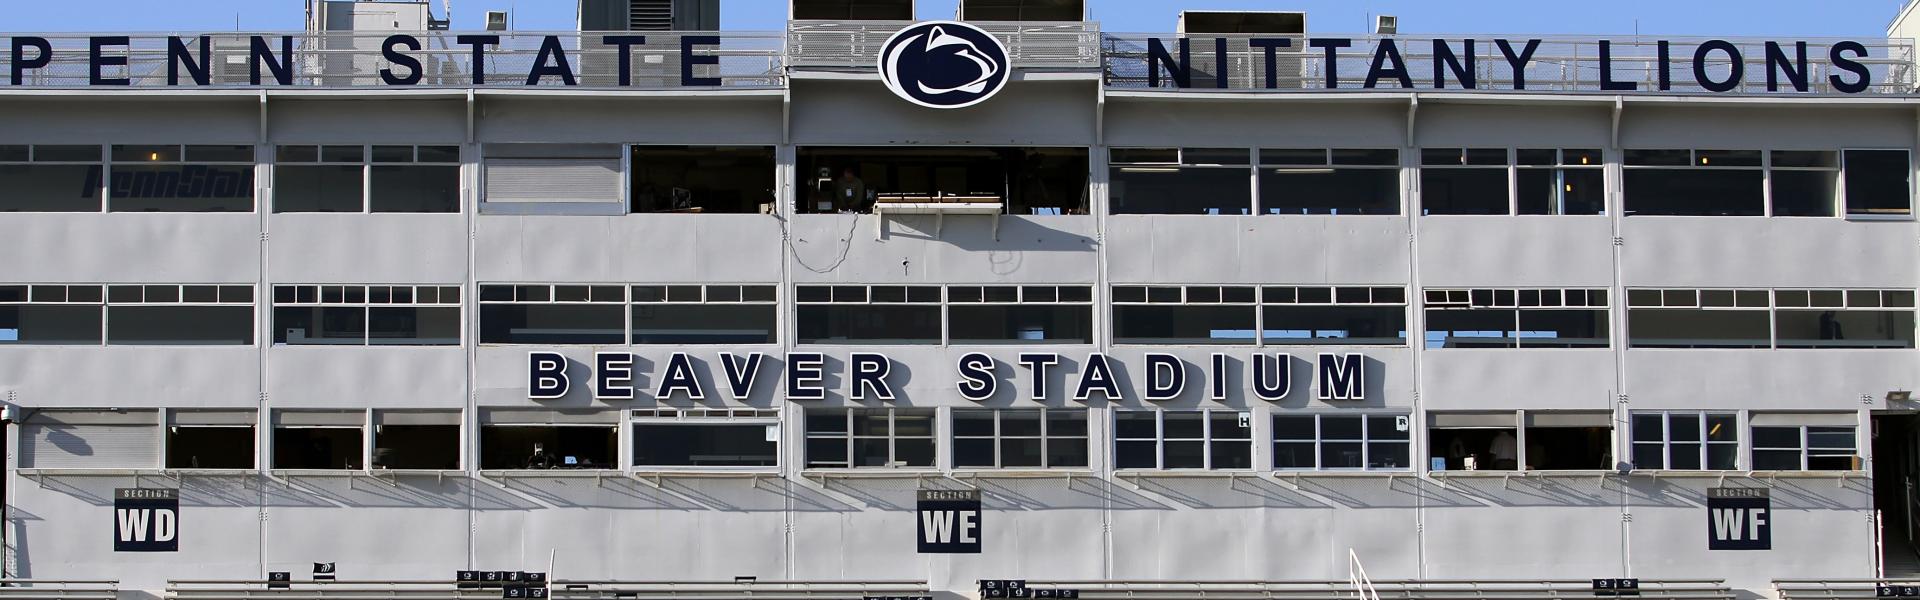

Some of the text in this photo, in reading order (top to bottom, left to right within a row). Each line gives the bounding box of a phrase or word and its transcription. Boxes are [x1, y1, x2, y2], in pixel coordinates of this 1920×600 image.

[11, 35, 722, 86] PENN STATE
[1148, 38, 1871, 93] NITTANY LIONS
[528, 351, 1365, 401] BEAVER STADIUM
[124, 489, 169, 498] SECTION
[926, 491, 972, 499] SECTION
[1716, 489, 1760, 497] SECTION
[117, 508, 176, 542] WD
[922, 510, 977, 543] WE
[1712, 508, 1766, 540] WF
